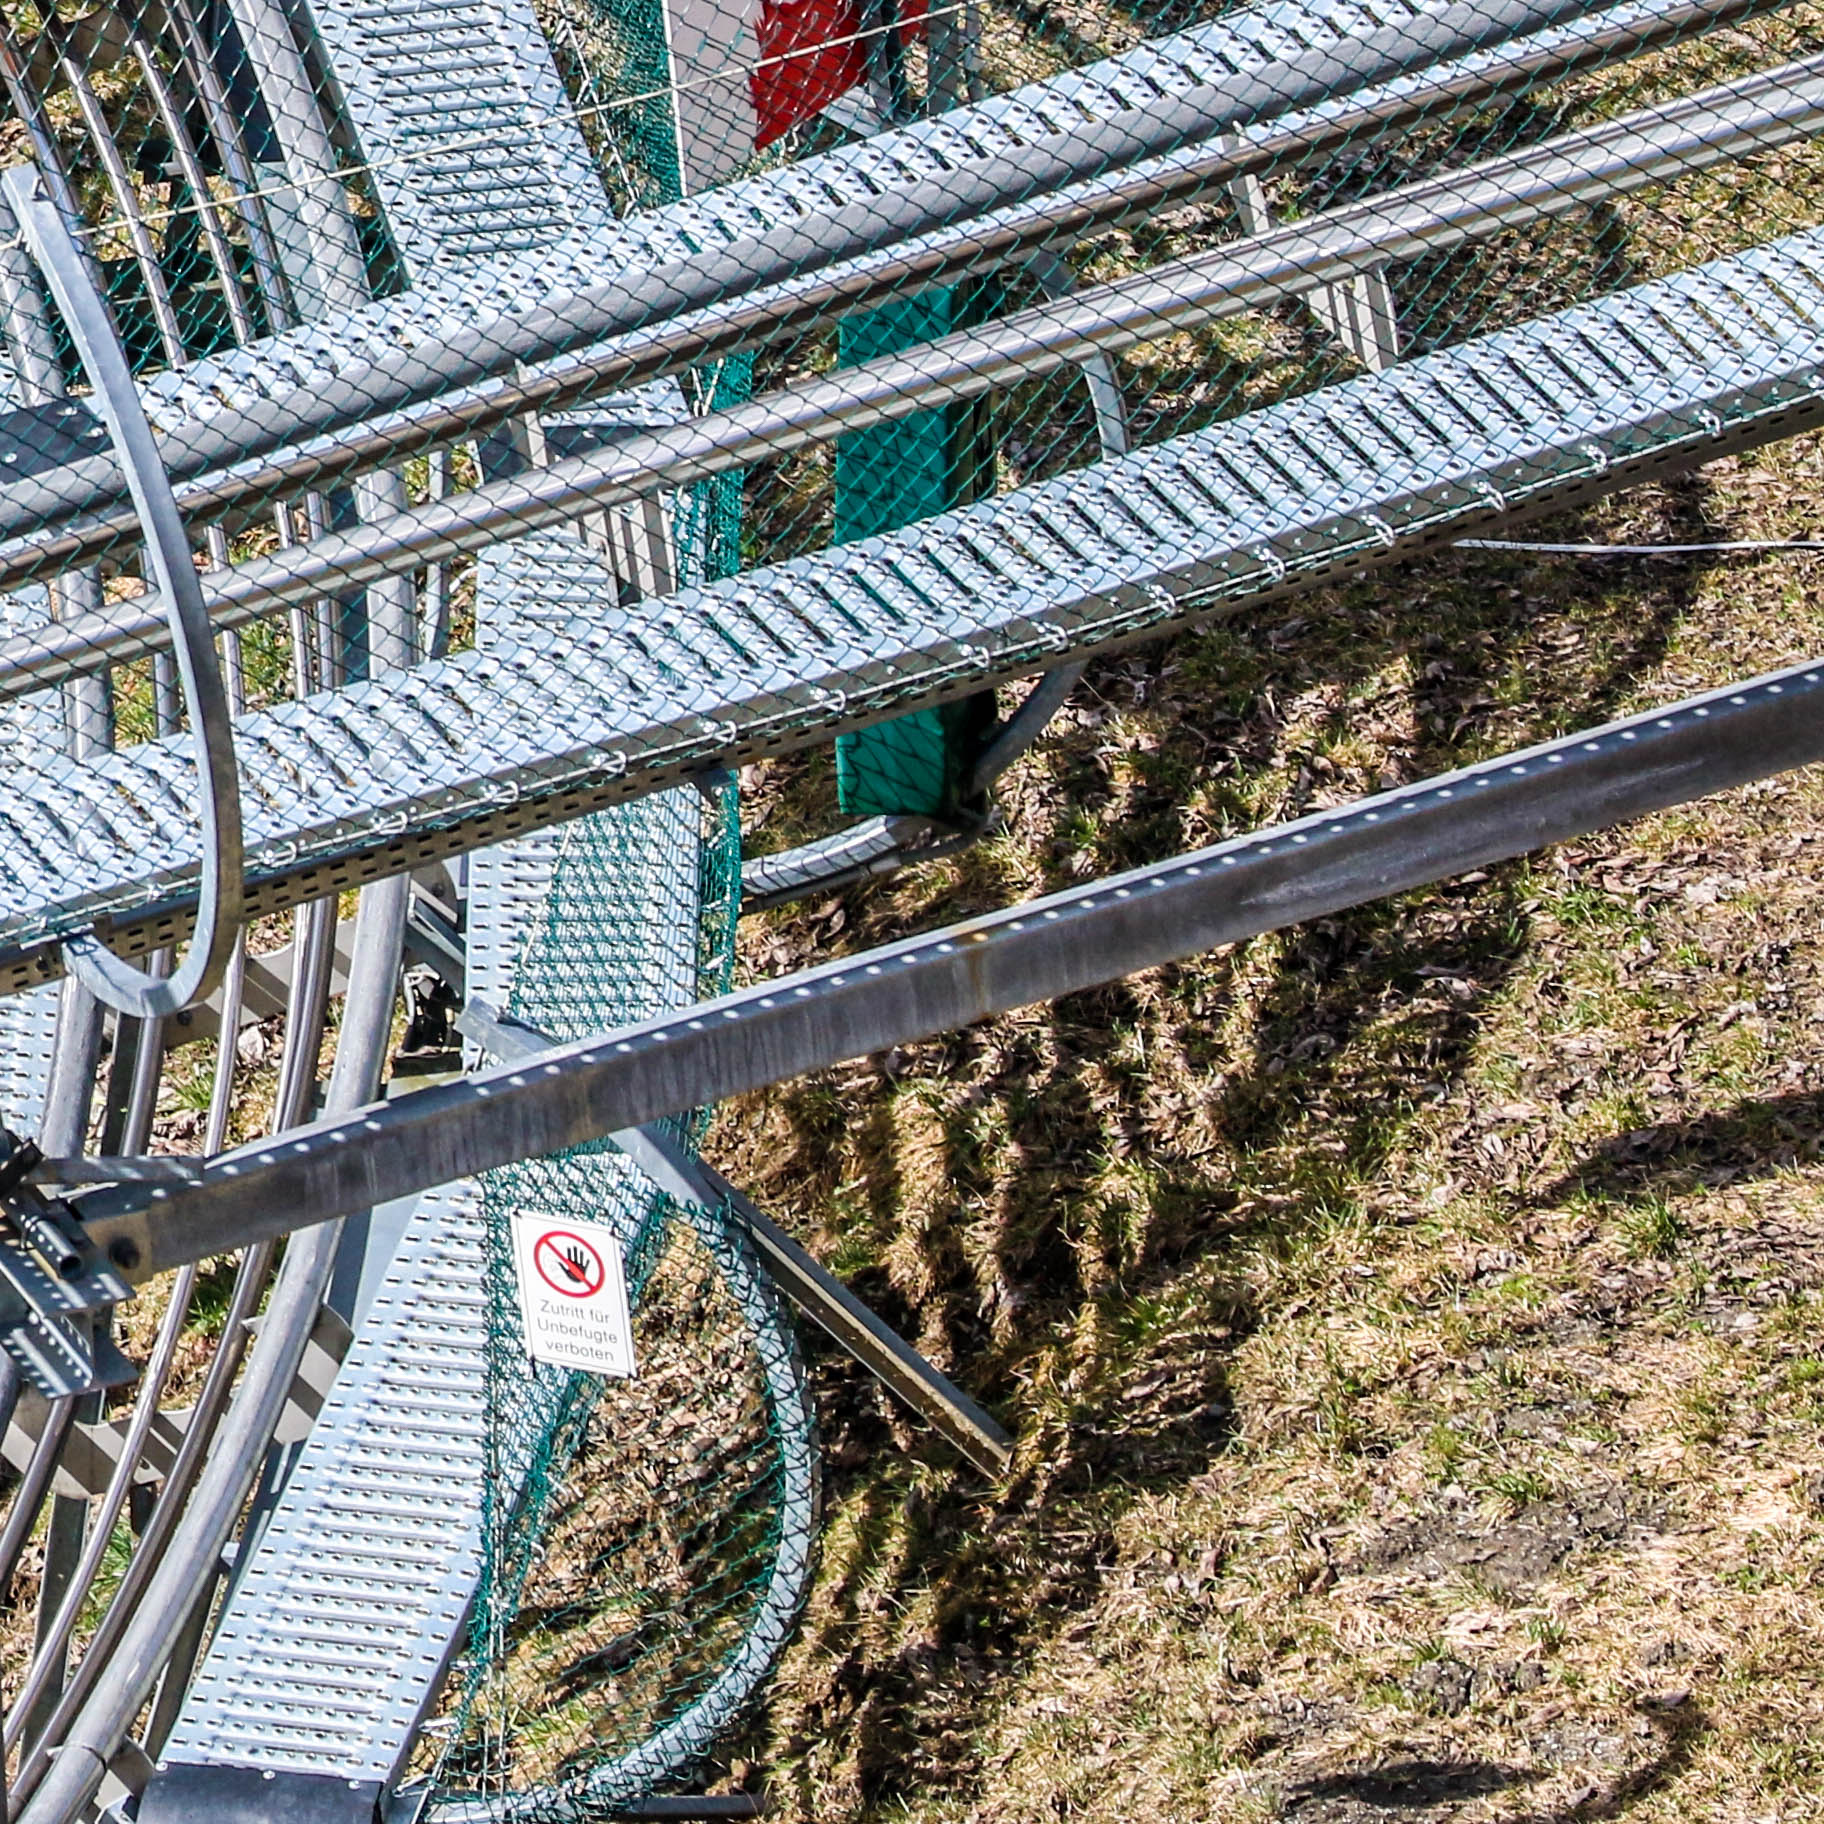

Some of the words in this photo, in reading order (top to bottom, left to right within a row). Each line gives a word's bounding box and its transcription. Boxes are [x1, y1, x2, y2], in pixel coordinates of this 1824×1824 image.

[540, 1298, 586, 1321] Zutritt
[589, 1308, 611, 1324] für
[537, 1317, 618, 1344] Unbefugte
[545, 1340, 614, 1362] verboten
